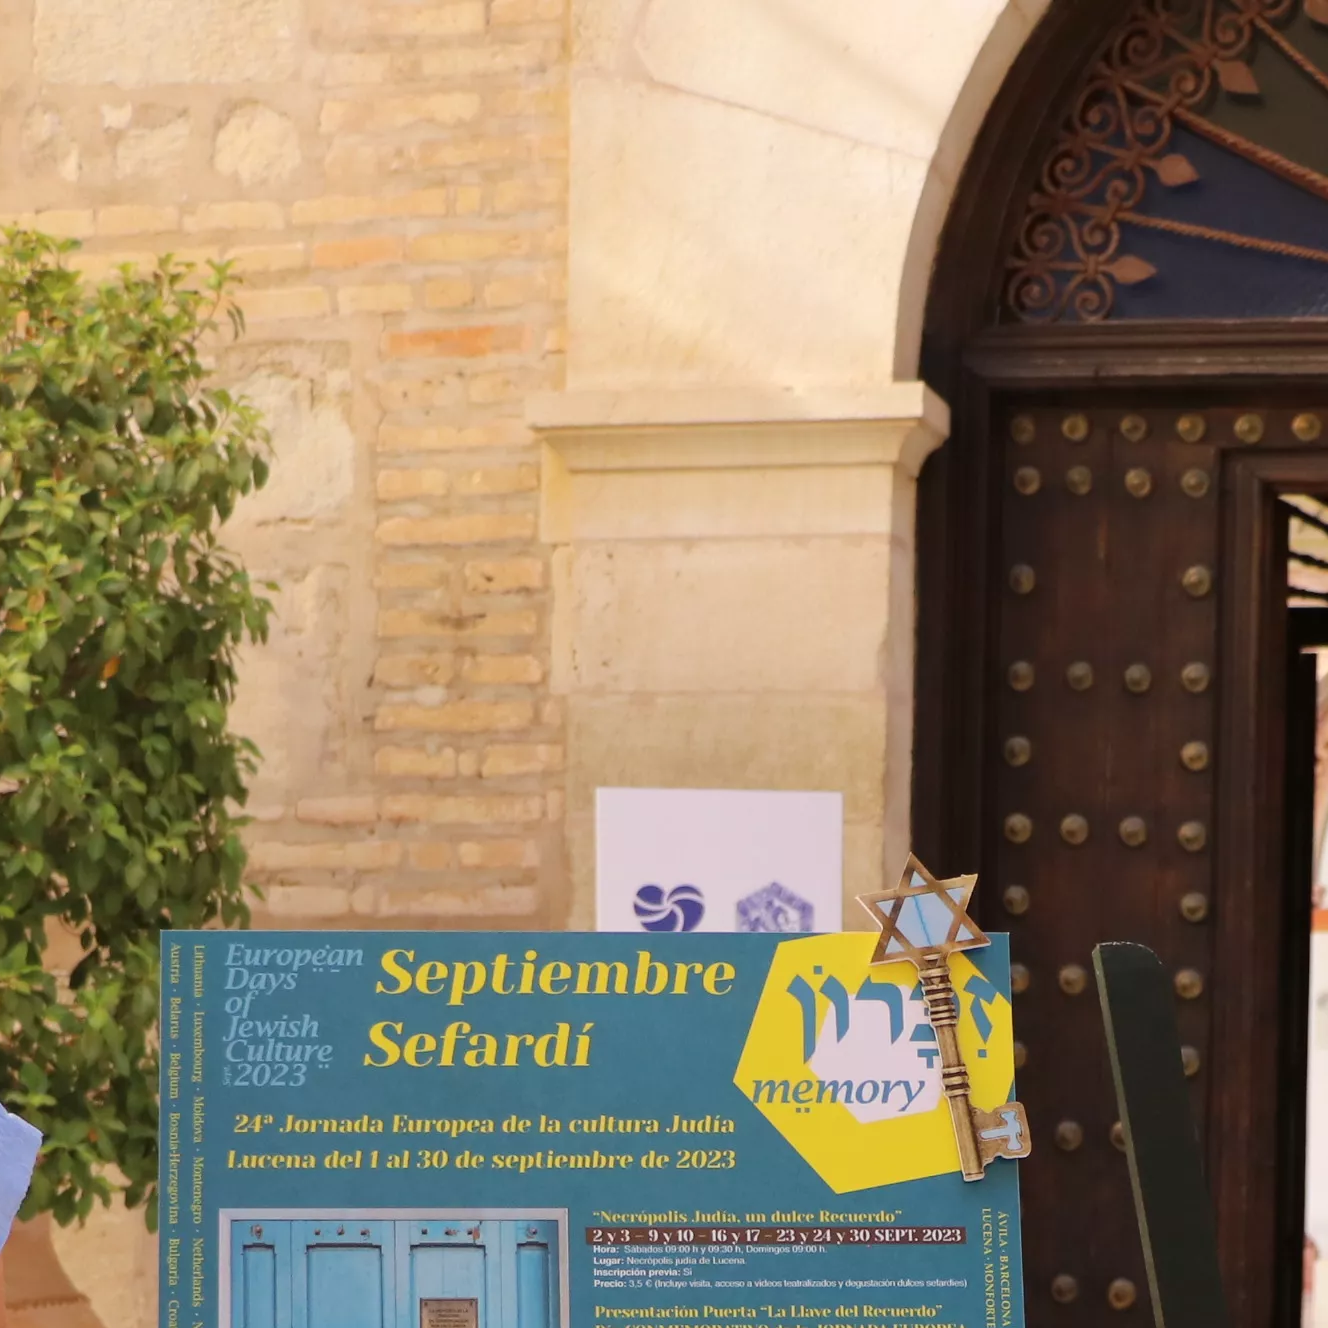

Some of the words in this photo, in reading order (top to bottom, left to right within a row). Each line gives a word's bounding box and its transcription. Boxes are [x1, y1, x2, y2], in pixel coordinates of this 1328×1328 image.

[170, 942, 181, 985] Austria
[194, 943, 206, 998] Lithuania
[225, 943, 364, 972] European
[375, 949, 736, 1003] Septiembre
[224, 967, 299, 995] Days
[169, 997, 182, 1039] Belarus
[224, 990, 259, 1019] of
[191, 1012, 205, 1084] Luxembourg
[222, 1014, 319, 1041] Jewish
[363, 1021, 594, 1068] Sefardí
[226, 1038, 333, 1068] Culture
[167, 1053, 182, 1099] Belgium
[233, 1063, 307, 1087] 2023
[752, 1079, 925, 1112] memory
[193, 1096, 205, 1143] Moldova
[279, 1114, 384, 1133] Jornada
[392, 1114, 495, 1138] Europea
[502, 1114, 532, 1133] de
[539, 1114, 562, 1134] la
[568, 1114, 659, 1134] cultura
[665, 1114, 735, 1134] Judía
[227, 1150, 316, 1169] Lucena
[323, 1150, 362, 1169] del
[370, 1150, 379, 1169] 1
[386, 1150, 410, 1169] al
[416, 1149, 450, 1169] 30
[455, 1150, 486, 1169] de
[491, 1150, 634, 1173] septiembre
[640, 1150, 670, 1169] de
[676, 1149, 736, 1169] 2023
[190, 1157, 206, 1224] Montenegro
[745, 1213, 766, 1223] un
[770, 1210, 815, 1223] dulce
[166, 1238, 181, 1286] Bulgaria
[192, 1238, 206, 1308] Netherlands
[984, 1263, 997, 1328] MONFORTE
[999, 1255, 1011, 1327] BARCELONA
